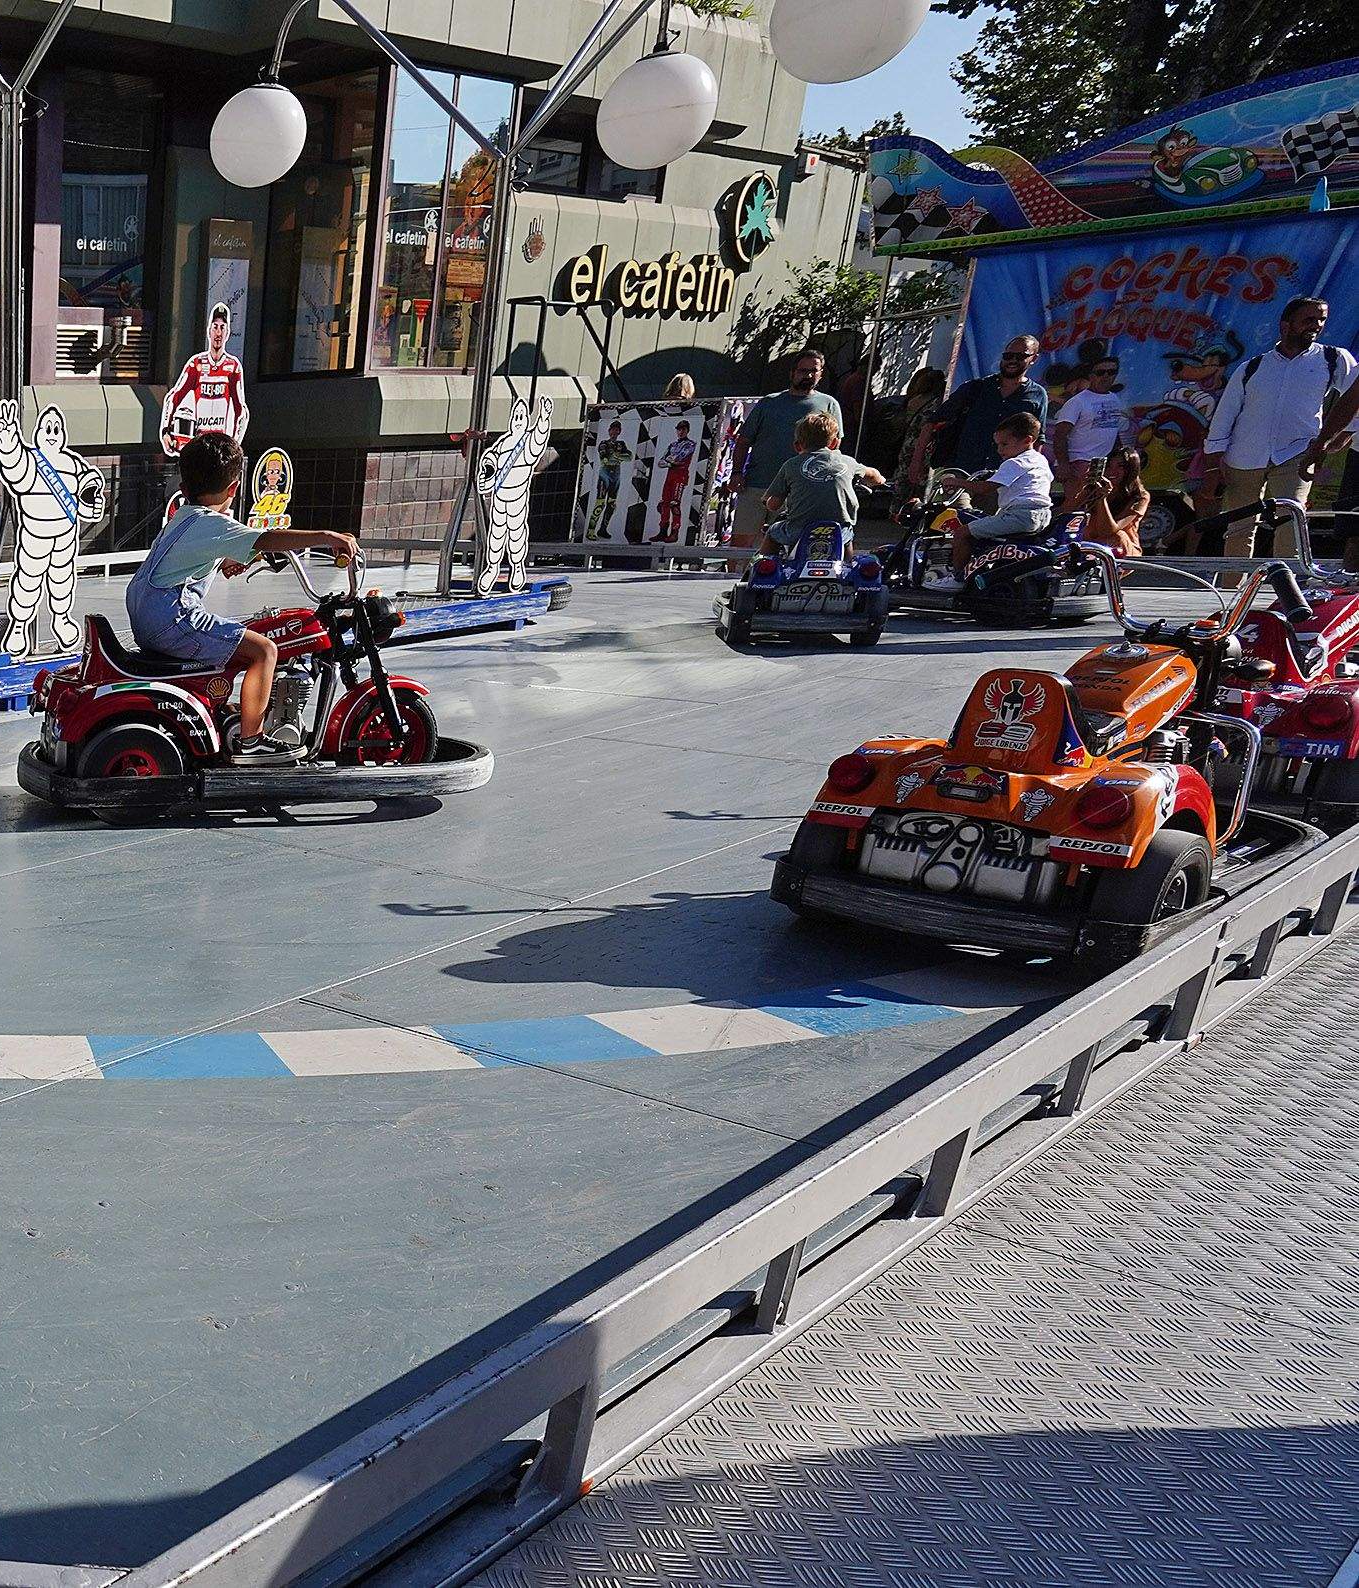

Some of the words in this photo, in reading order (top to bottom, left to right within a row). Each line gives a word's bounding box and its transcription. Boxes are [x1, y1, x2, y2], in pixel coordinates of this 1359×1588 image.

[395, 230, 427, 247] cafetin
[444, 234, 453, 249] el
[570, 243, 608, 303] el
[619, 250, 735, 313] cafetin
[1062, 244, 1297, 304] COCHES
[1039, 304, 1217, 352] CHOQUE
[197, 416, 225, 427] DUCATI
[32, 448, 77, 518] MICHELIN
[254, 493, 289, 516] 46
[995, 739, 1028, 750] LORENZO
[1306, 742, 1340, 756] TIM
[815, 802, 864, 816] REPSOL
[1059, 838, 1123, 855] REPSOL
